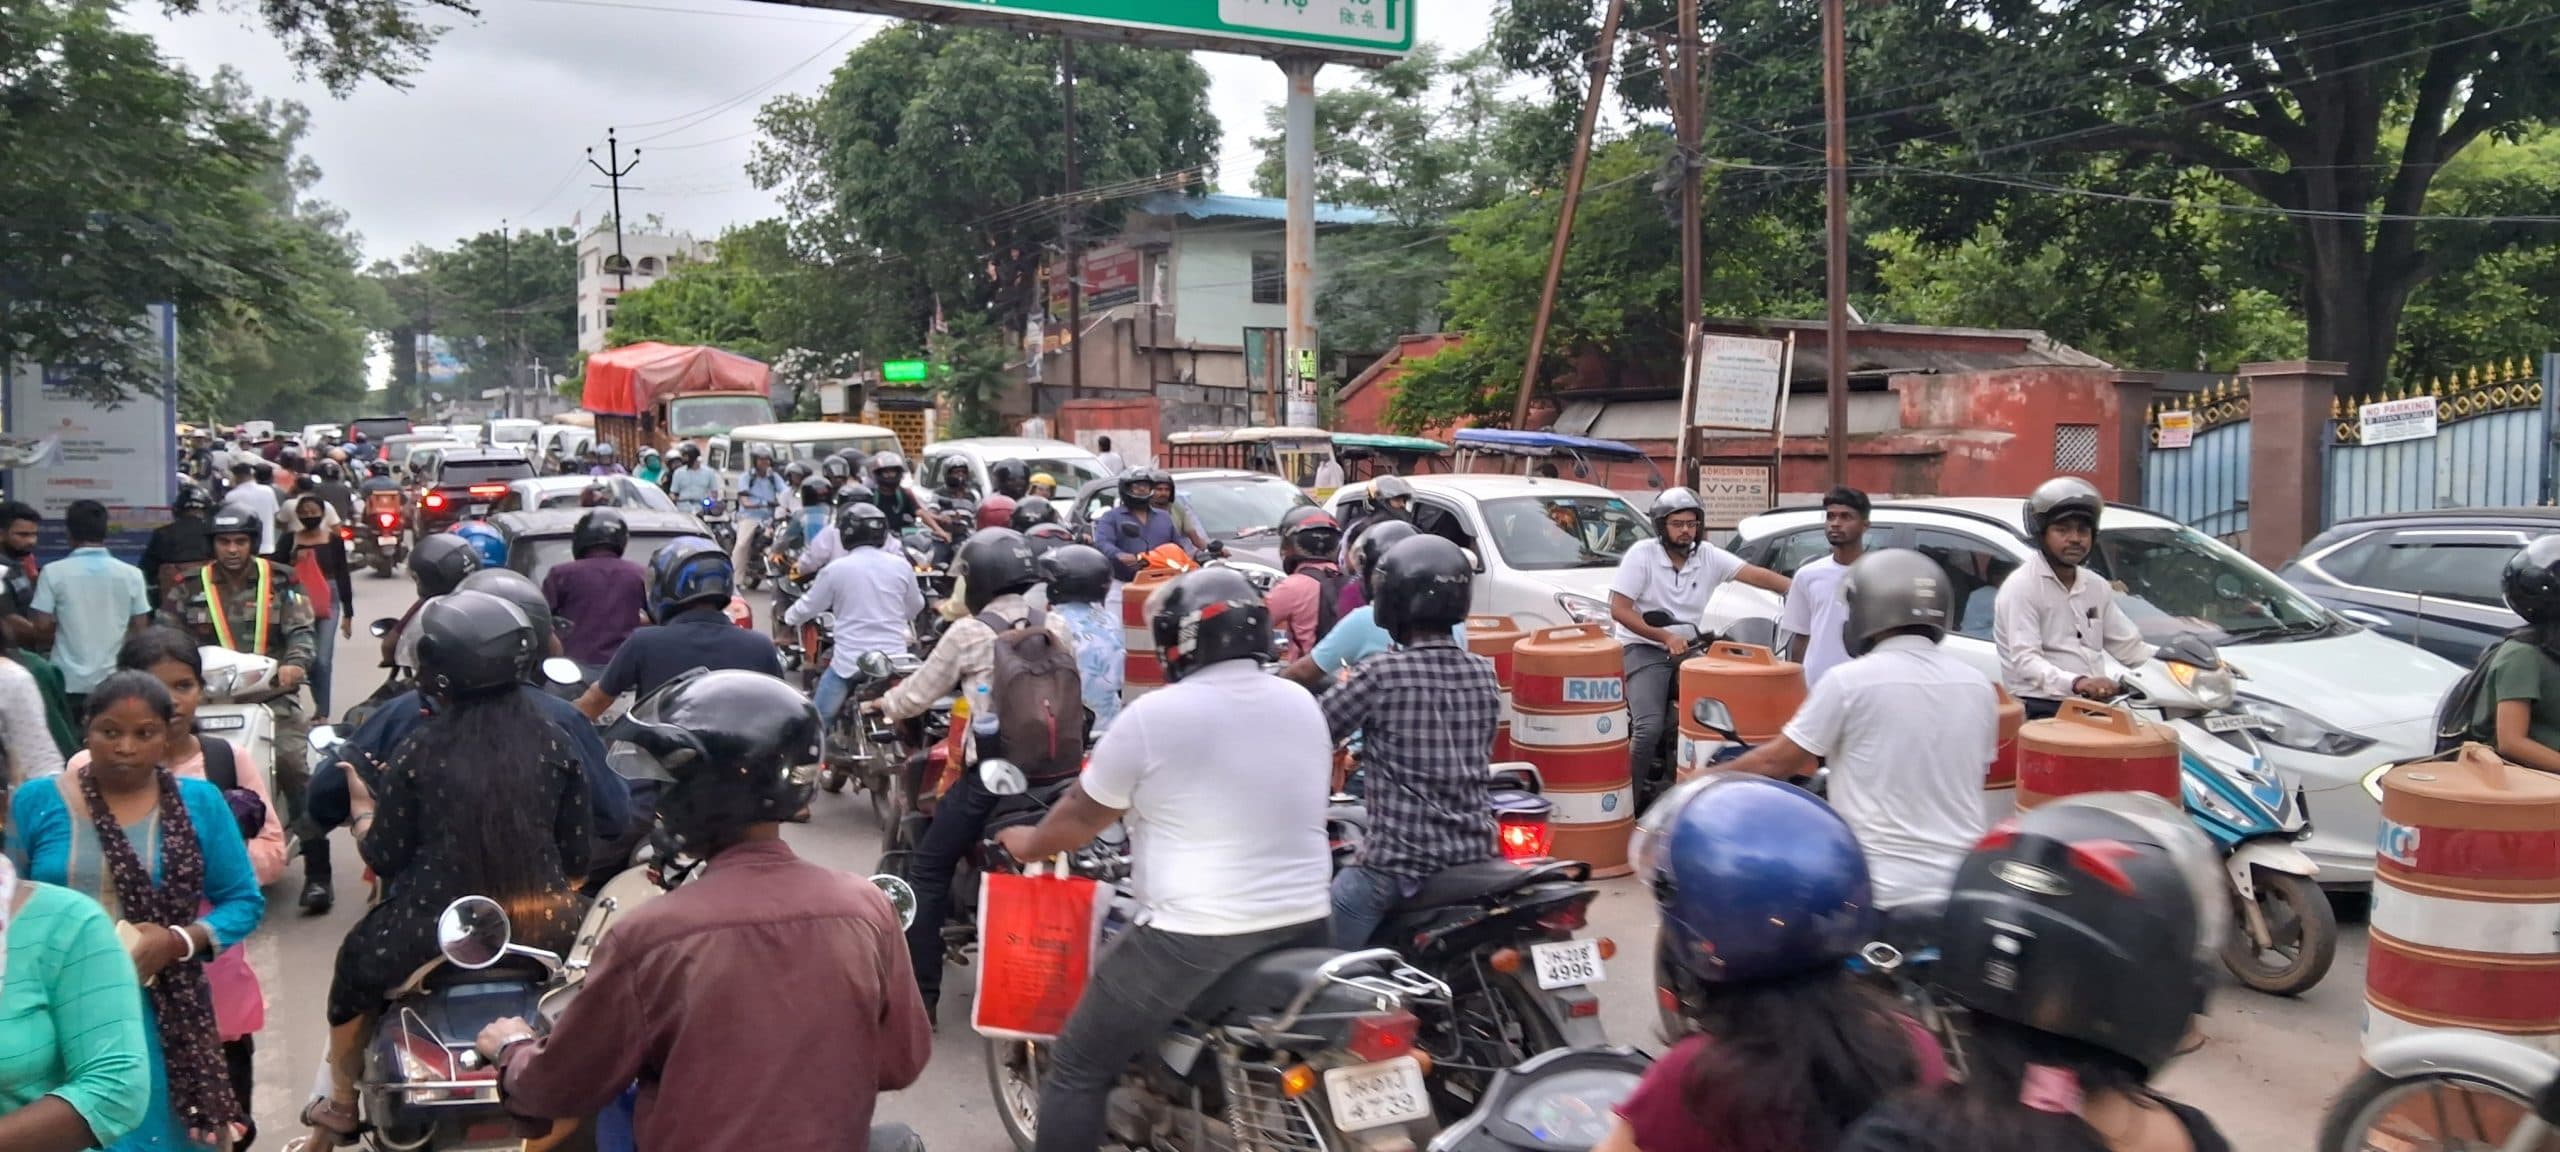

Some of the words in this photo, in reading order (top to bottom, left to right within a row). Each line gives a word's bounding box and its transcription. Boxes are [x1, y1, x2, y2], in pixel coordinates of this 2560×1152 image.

[2366, 407, 2380, 416] NO
[2384, 401, 2430, 414] PARKING
[1702, 467, 1744, 476] ADMISSION
[1745, 467, 1767, 477] OPEN
[1706, 484, 1761, 495] VVPS
[1569, 680, 1621, 700] RMC
[1549, 962, 1594, 981] 4996
